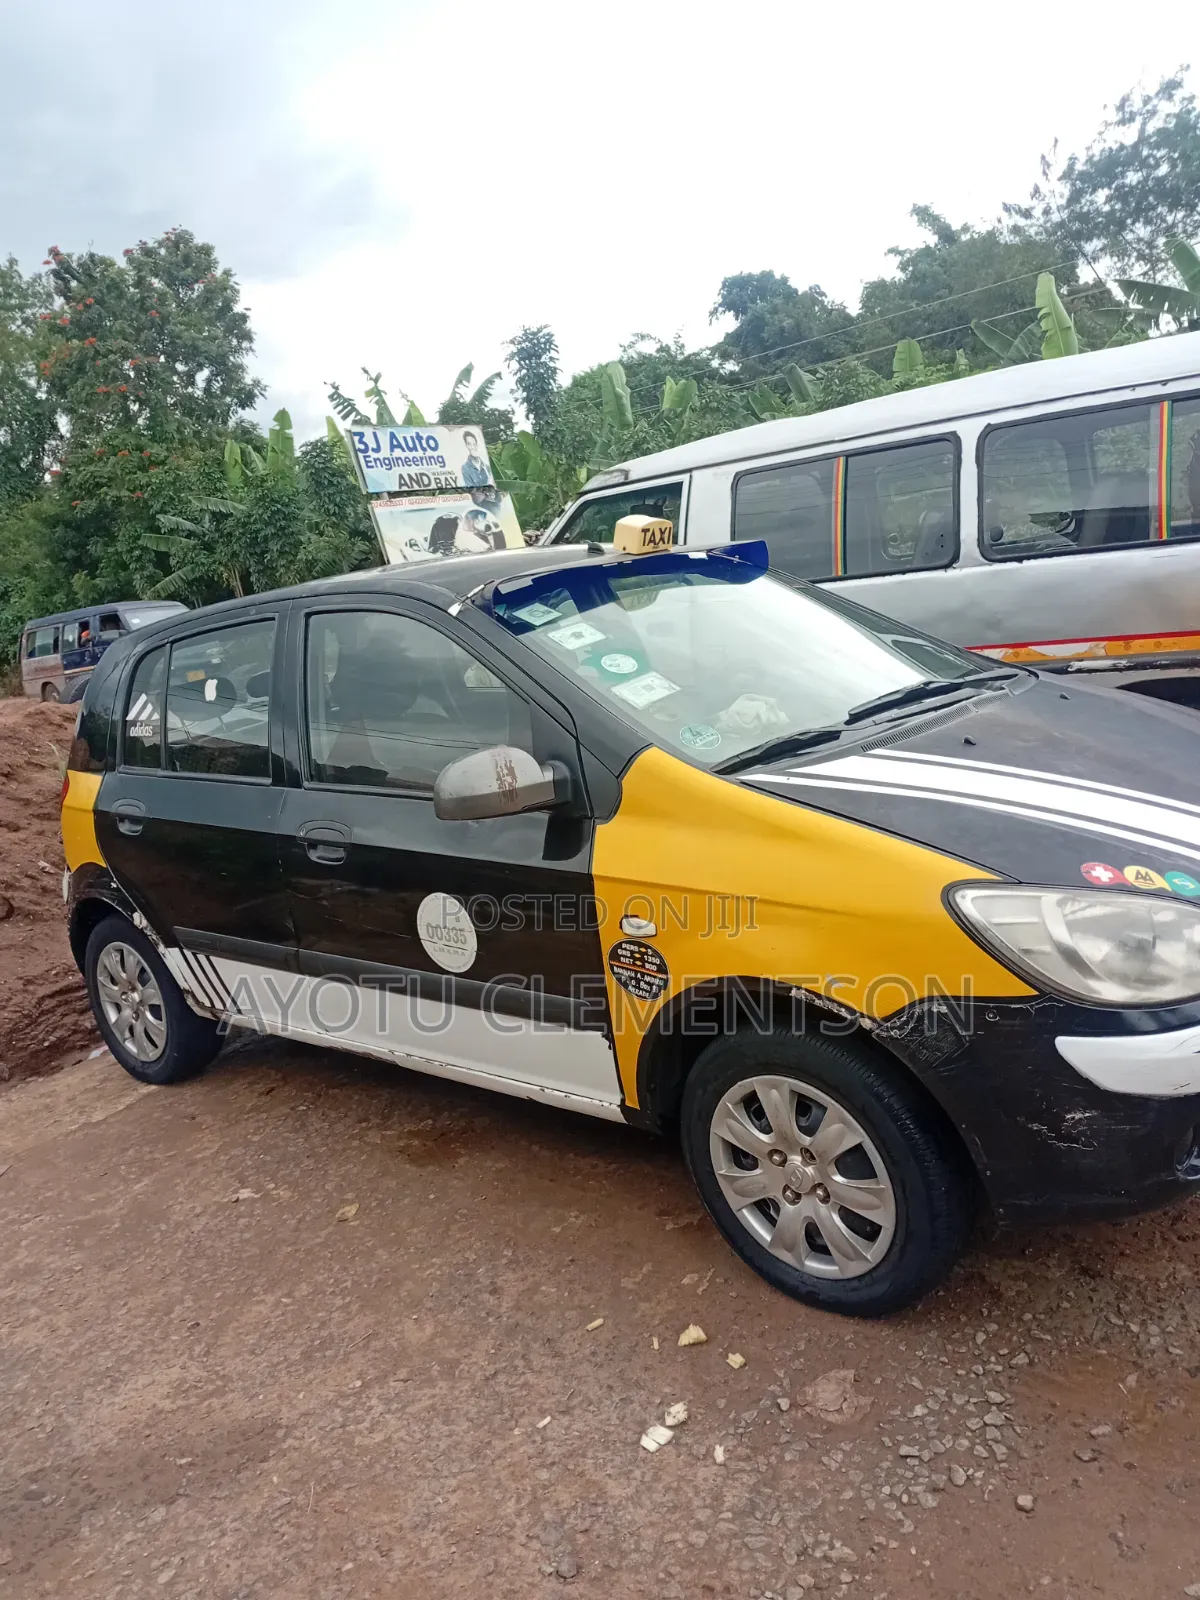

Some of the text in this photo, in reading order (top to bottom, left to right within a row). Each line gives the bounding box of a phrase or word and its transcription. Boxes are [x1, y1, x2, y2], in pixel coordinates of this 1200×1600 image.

[352, 430, 440, 454] 3J Auto
[362, 453, 446, 471] Engineering
[398, 471, 432, 490] AND
[434, 475, 458, 489] BAY
[641, 526, 673, 547] TAXI
[129, 721, 153, 737] adidas
[425, 922, 468, 945] 00335
[621, 943, 639, 952] PERS
[617, 949, 660, 965] GRS 1350
[620, 957, 634, 965] NET
